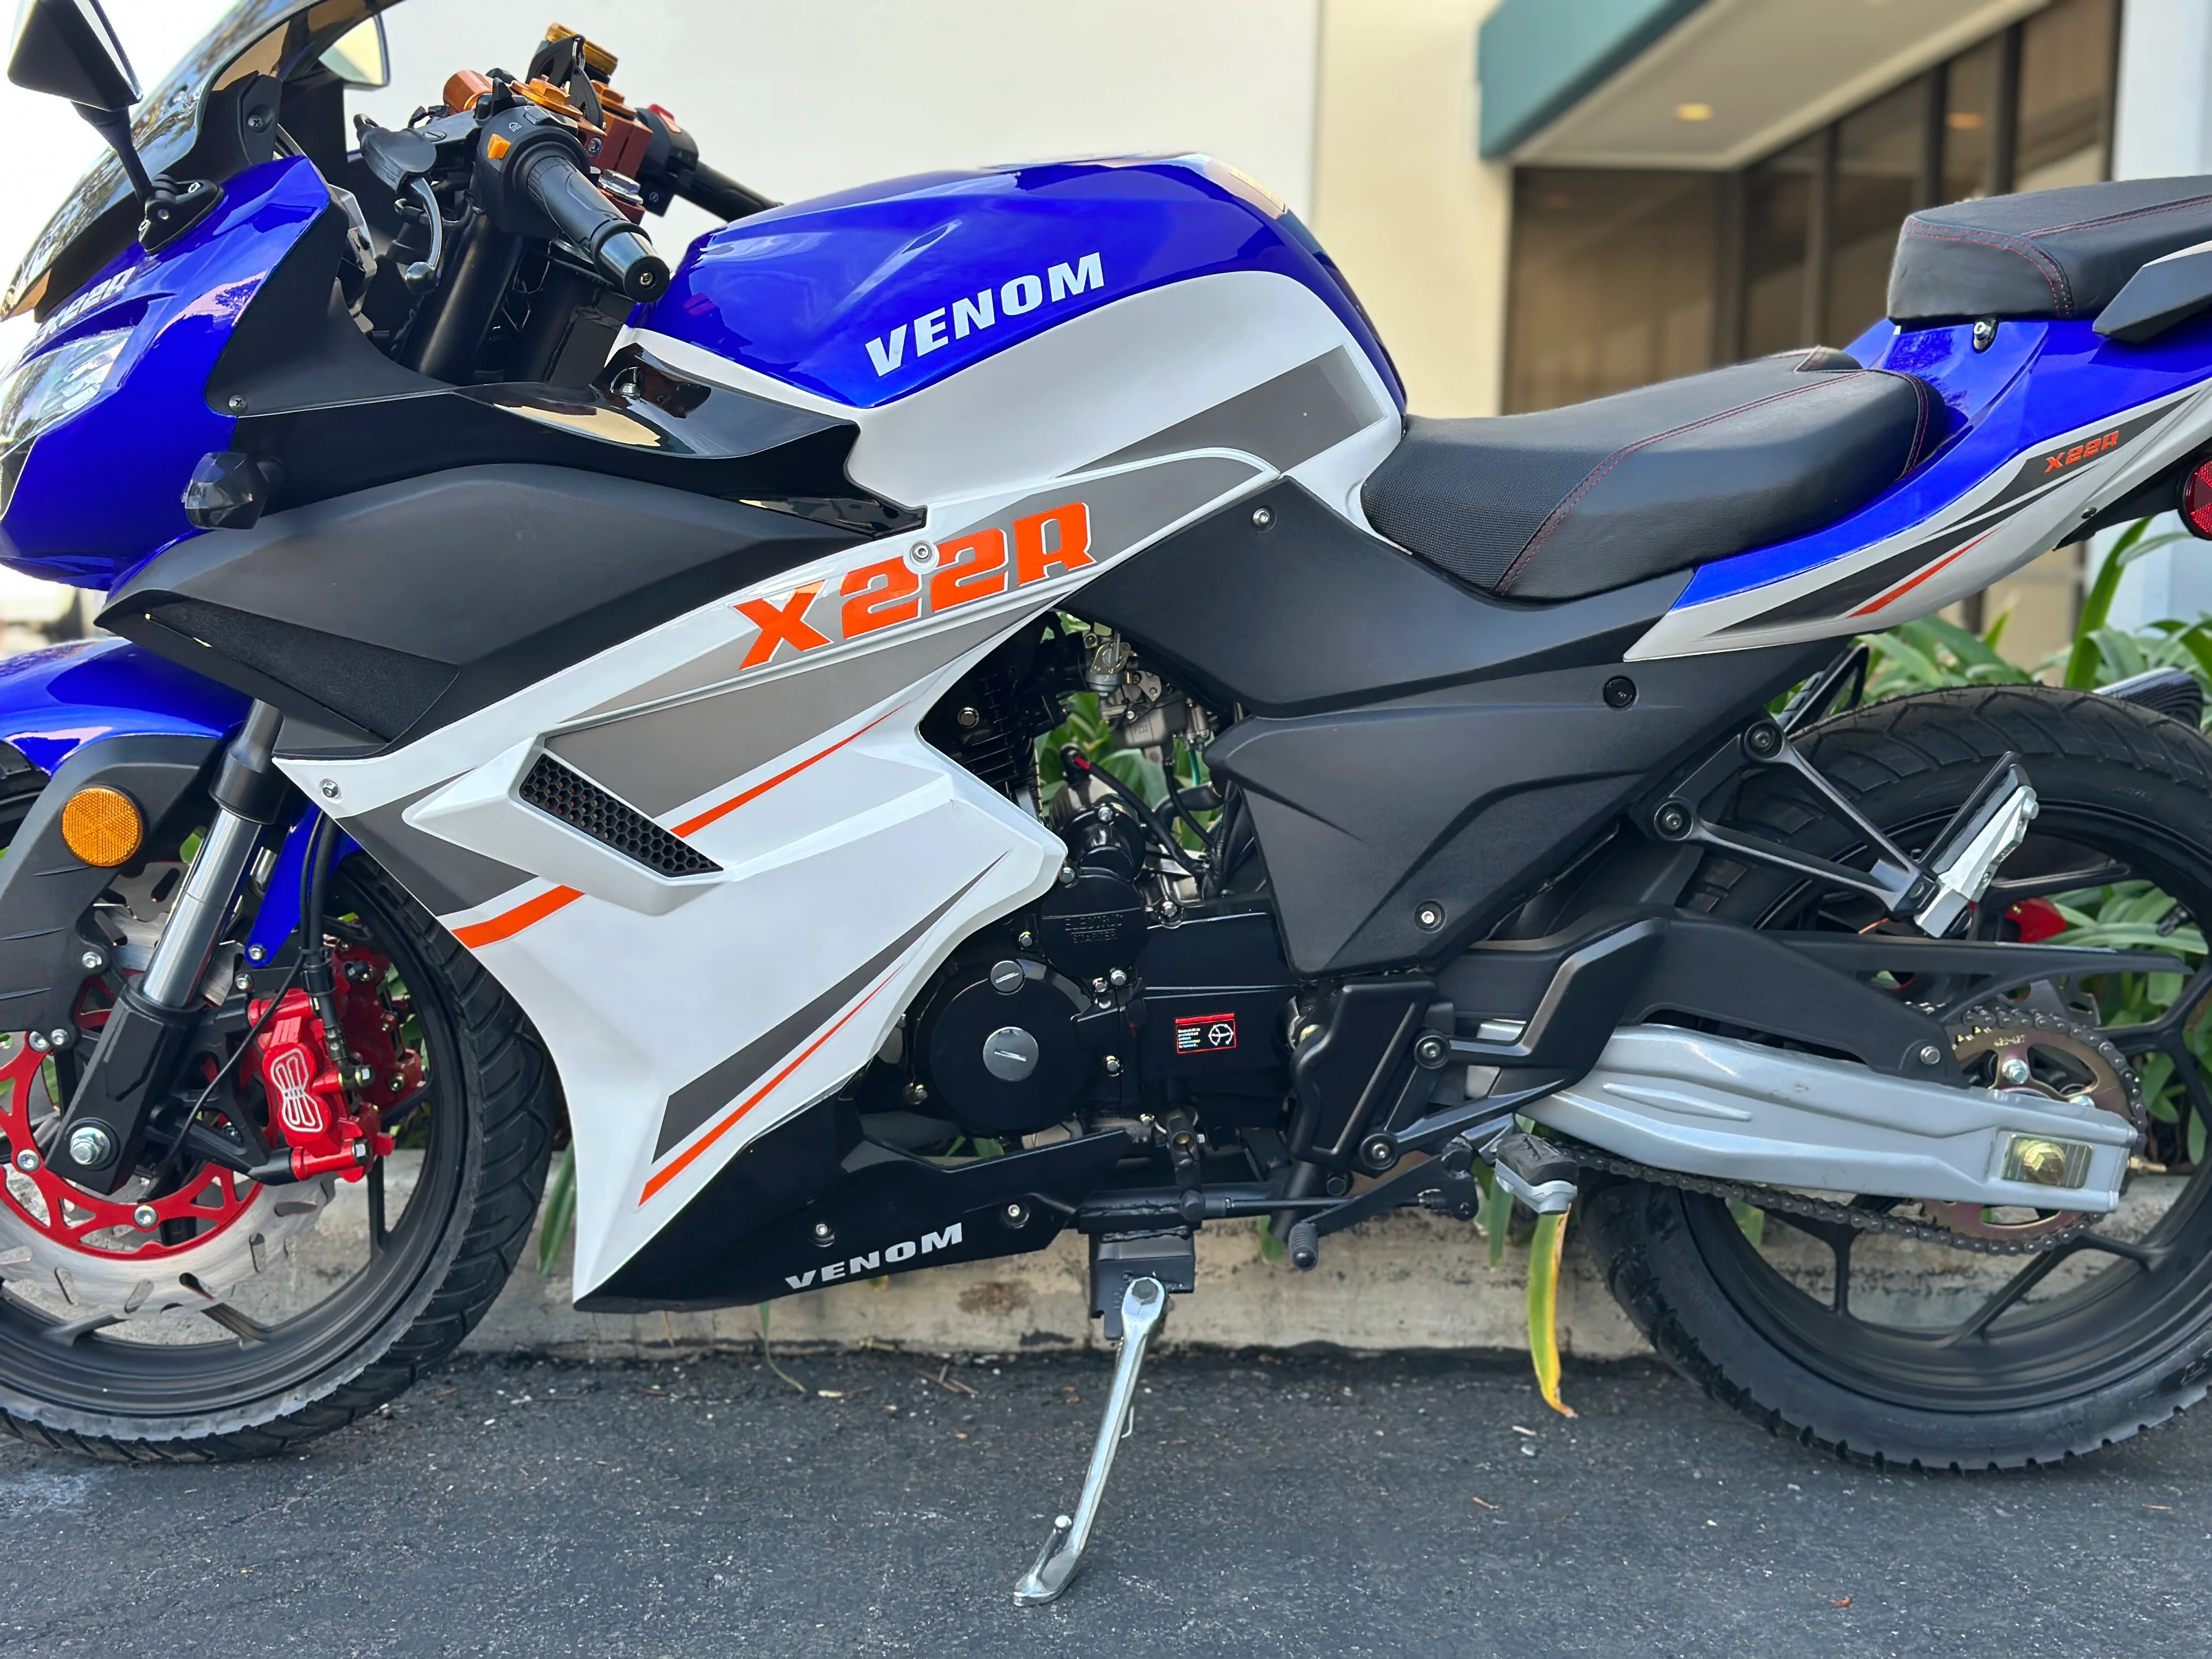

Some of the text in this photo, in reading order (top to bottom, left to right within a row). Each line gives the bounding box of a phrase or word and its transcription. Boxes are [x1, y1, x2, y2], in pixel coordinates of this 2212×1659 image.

[865, 252, 1104, 377] VENOM
[2045, 430, 2119, 473] X22R
[732, 501, 1097, 670] X22R
[785, 1222, 962, 1289] VENOM
